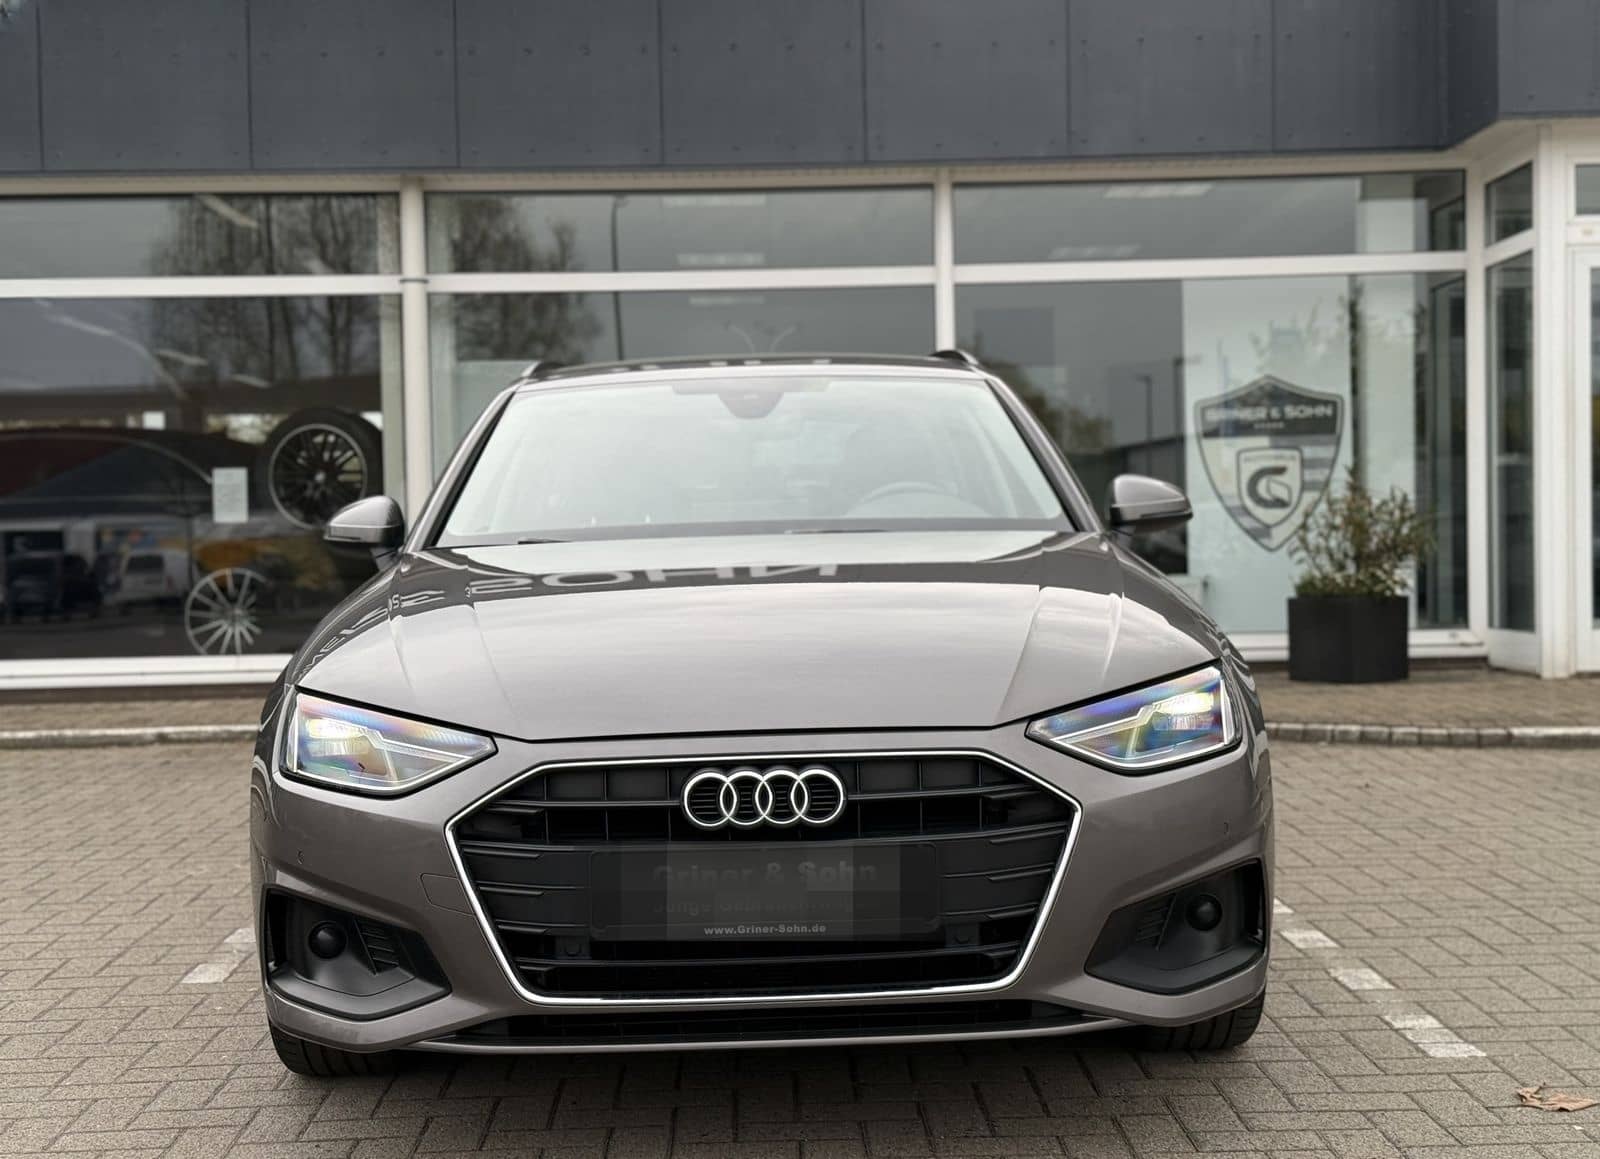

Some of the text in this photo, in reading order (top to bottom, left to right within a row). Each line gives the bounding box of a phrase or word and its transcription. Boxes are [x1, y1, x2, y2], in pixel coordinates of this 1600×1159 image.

[653, 864, 752, 886] Griner
[798, 860, 878, 884] Sohn
[703, 923, 827, 935] www.Griner-Sohn.de
